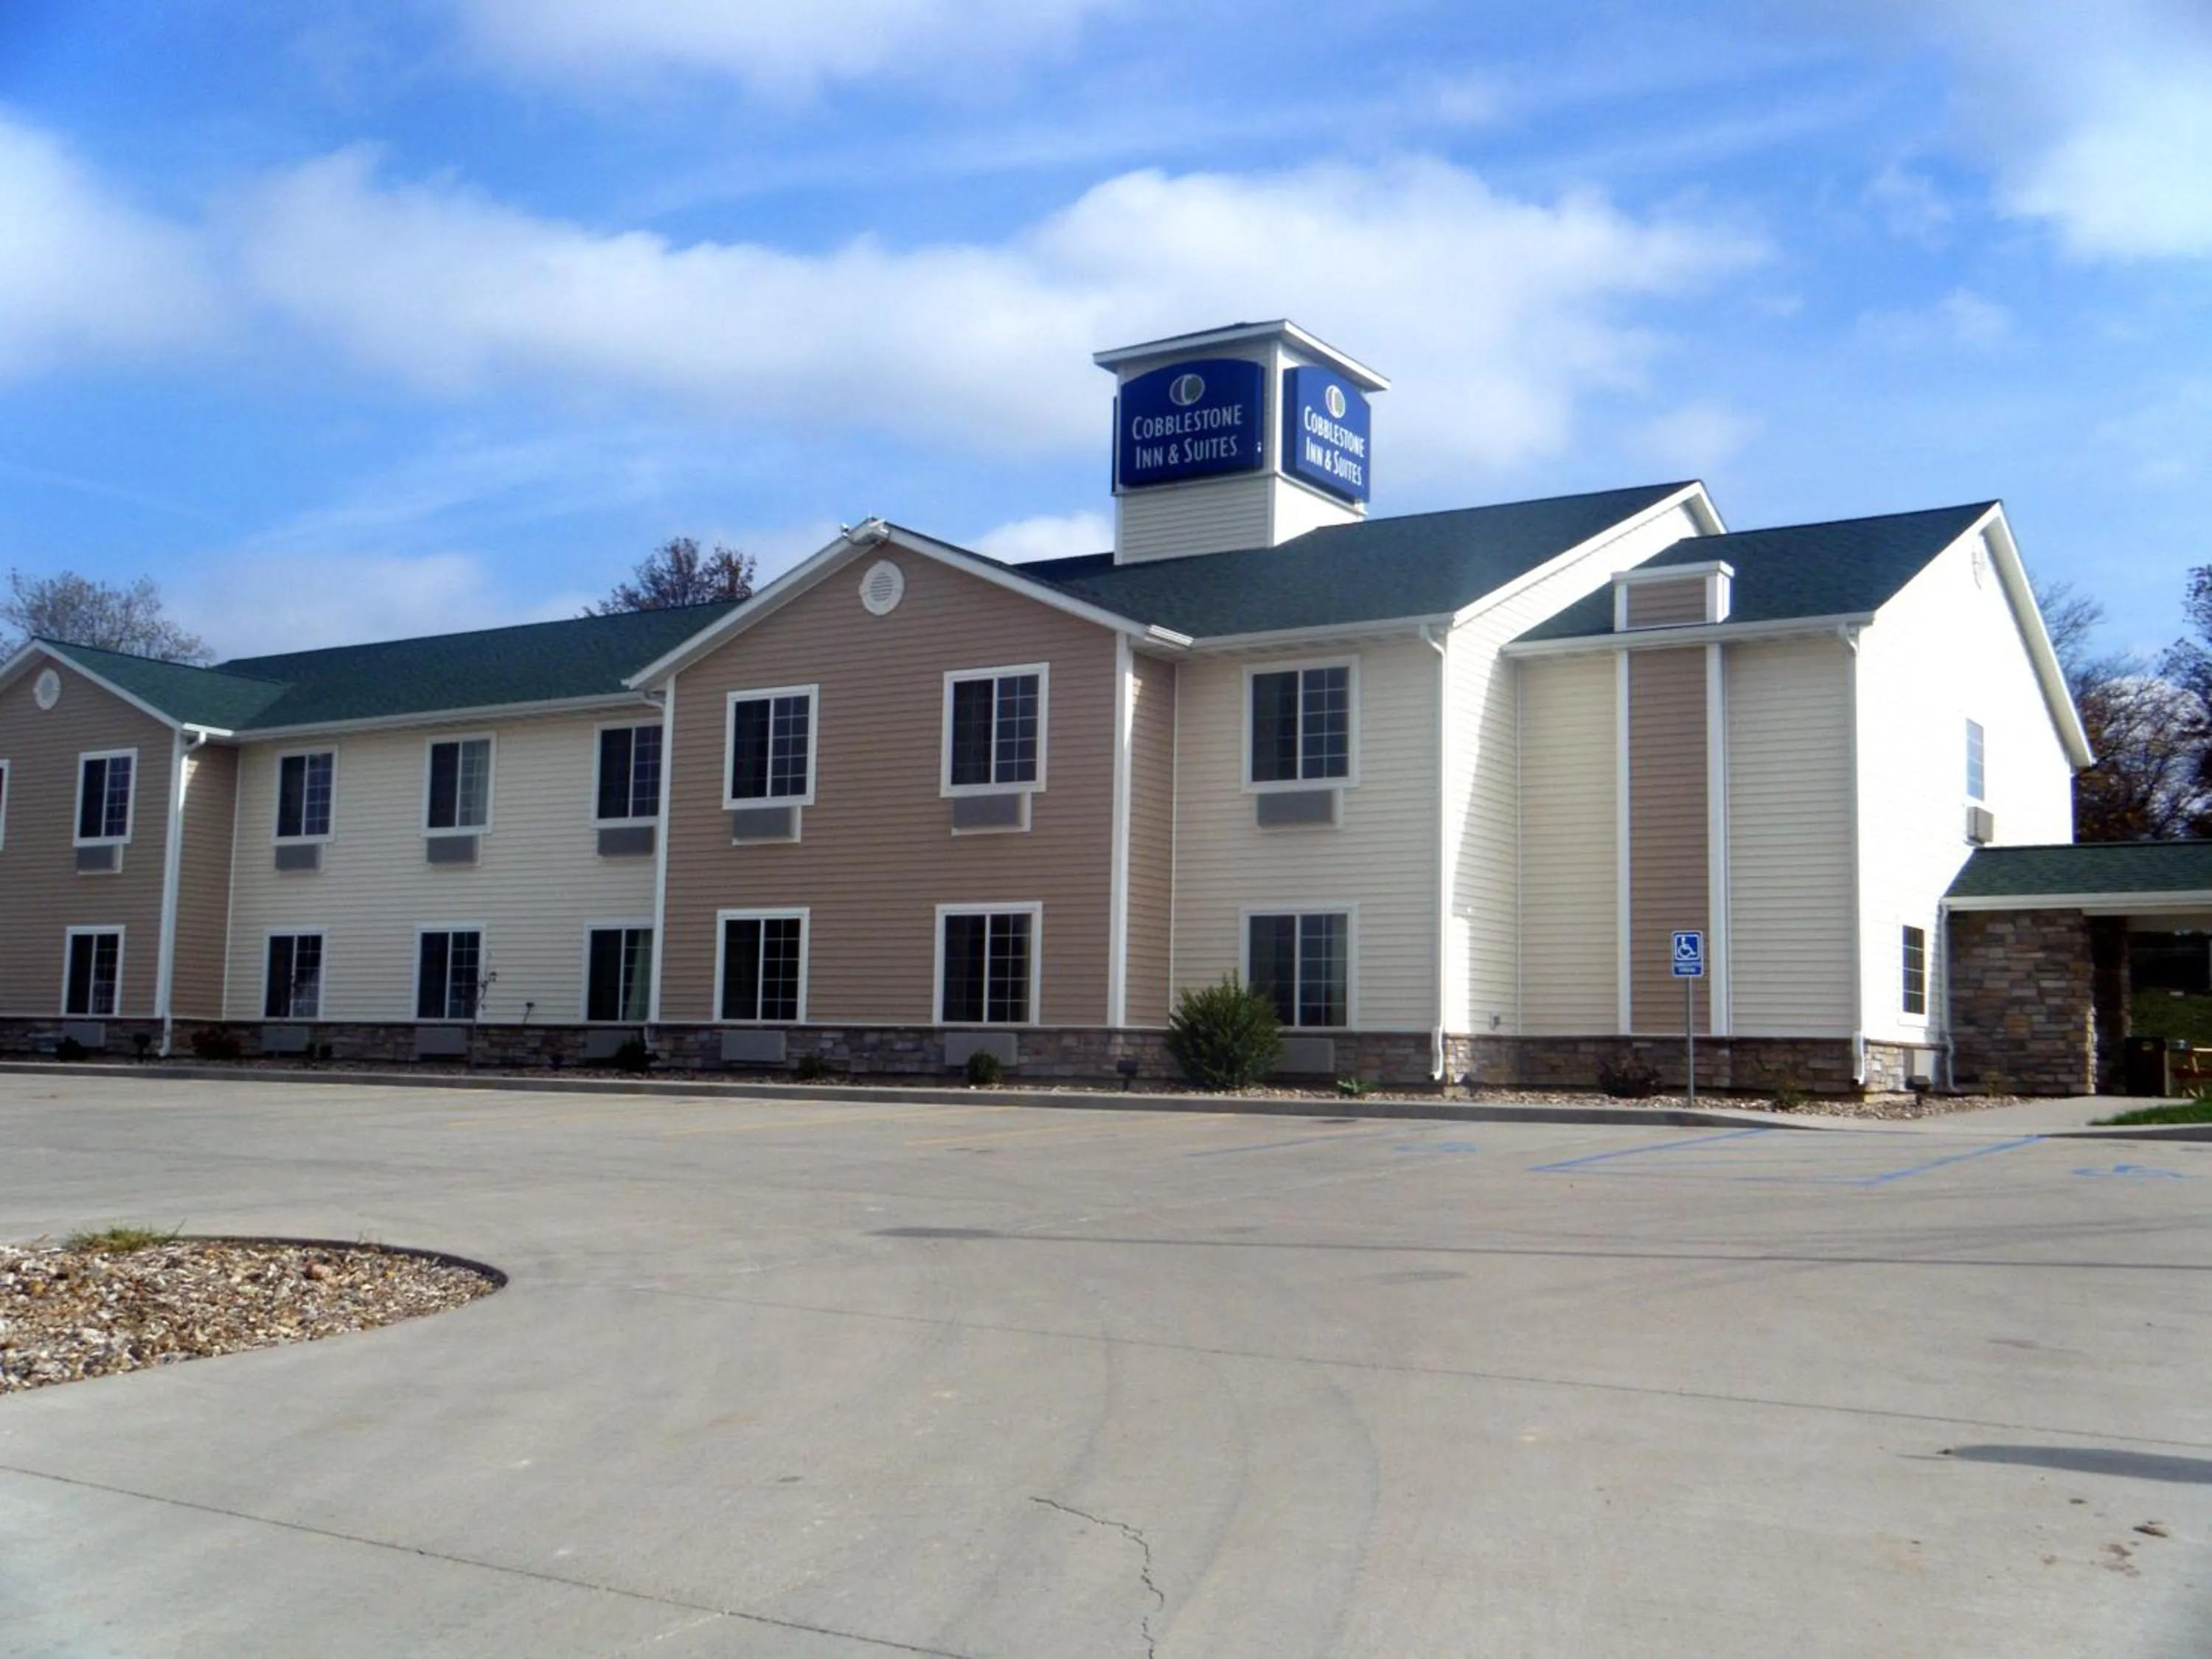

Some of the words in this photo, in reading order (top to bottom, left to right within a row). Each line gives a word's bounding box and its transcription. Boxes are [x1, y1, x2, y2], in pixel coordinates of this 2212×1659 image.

[1132, 404, 1243, 441] COBBLESTONE
[1304, 406, 1365, 459] COBBLESTONE
[1135, 445, 1164, 470] INN
[1167, 445, 1180, 465] &
[1183, 435, 1239, 462] SUITES
[1306, 437, 1324, 467] INN
[1324, 452, 1332, 473] &
[1333, 451, 1362, 487] SUITES
